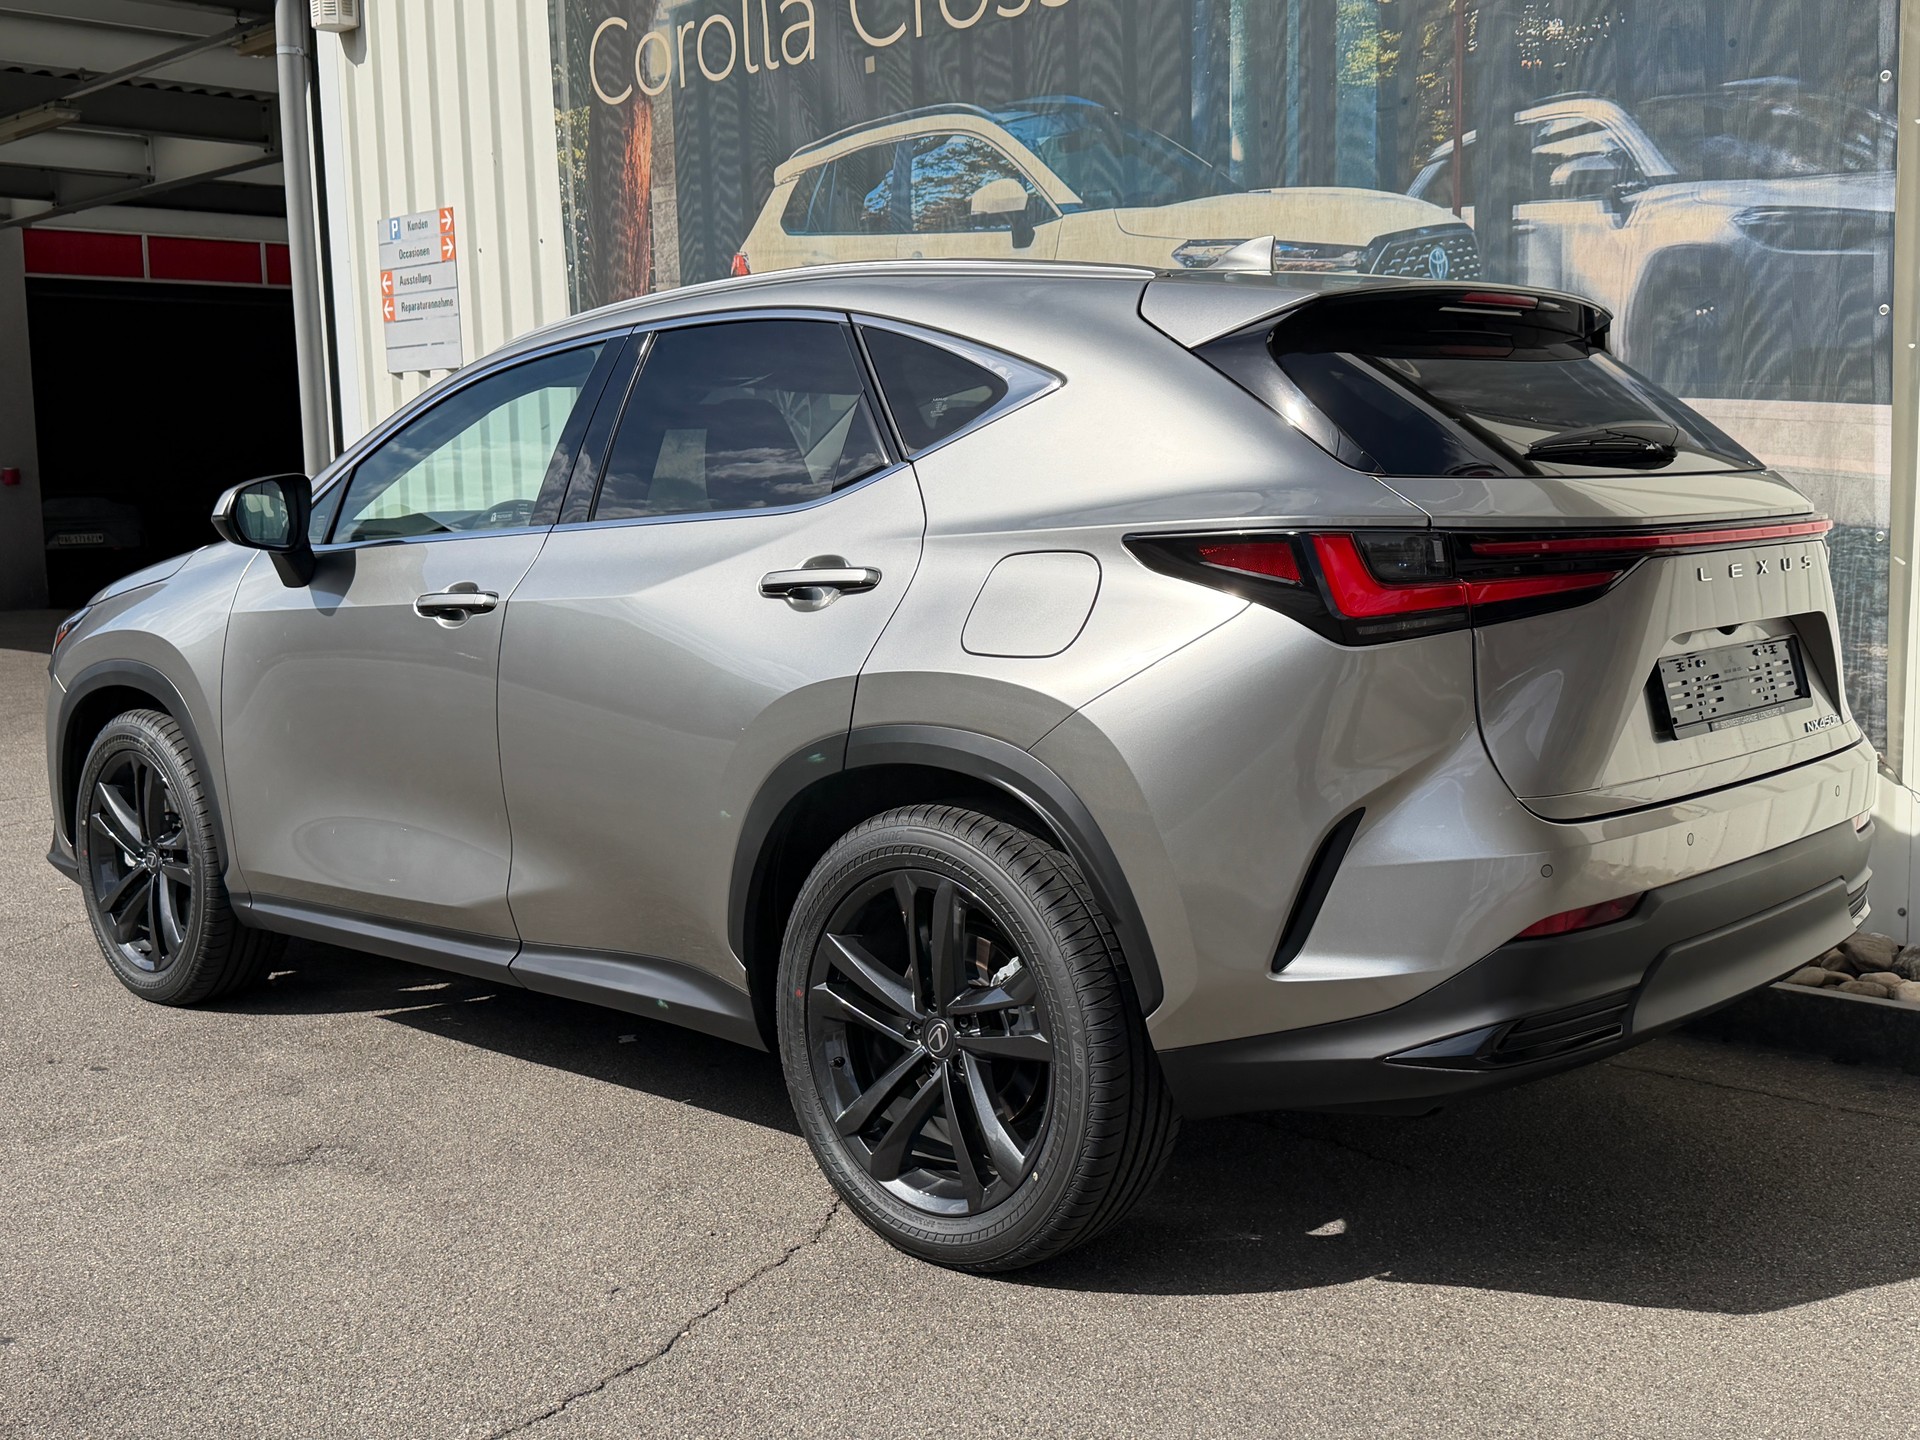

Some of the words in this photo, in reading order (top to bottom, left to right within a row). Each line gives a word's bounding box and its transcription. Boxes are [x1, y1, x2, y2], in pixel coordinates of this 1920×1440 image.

[589, 0, 815, 104] Corolla
[851, 0, 1069, 47] Cro
[391, 220, 399, 239] P
[407, 219, 429, 231] Kunden
[398, 246, 430, 260] Occasionen
[399, 273, 432, 286] Ausstellung
[401, 297, 454, 314] Reparaturannahme
[1697, 556, 1812, 581] LEXUS
